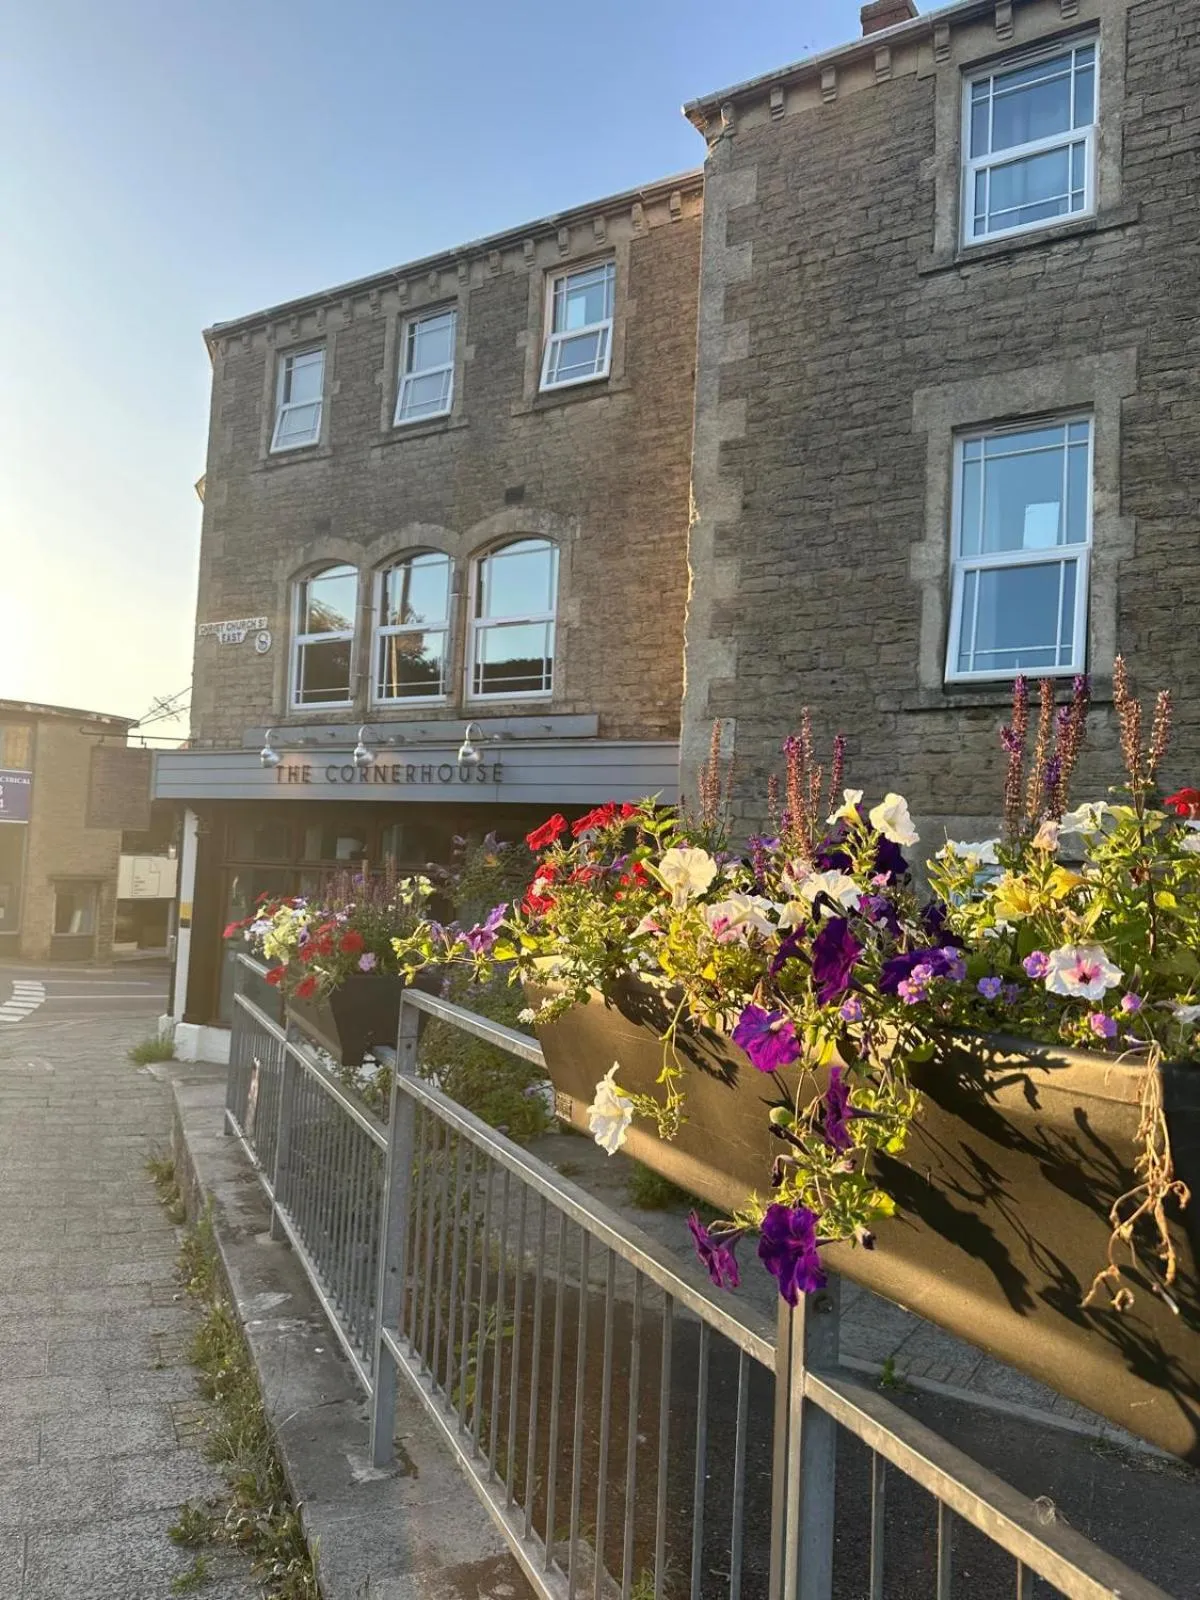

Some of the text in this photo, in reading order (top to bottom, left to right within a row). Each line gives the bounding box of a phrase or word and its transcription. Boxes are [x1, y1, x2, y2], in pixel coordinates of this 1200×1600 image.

[226, 619, 257, 630] CHURCH
[222, 632, 242, 642] EAST
[276, 763, 505, 784] THE CORNERHOUSE
